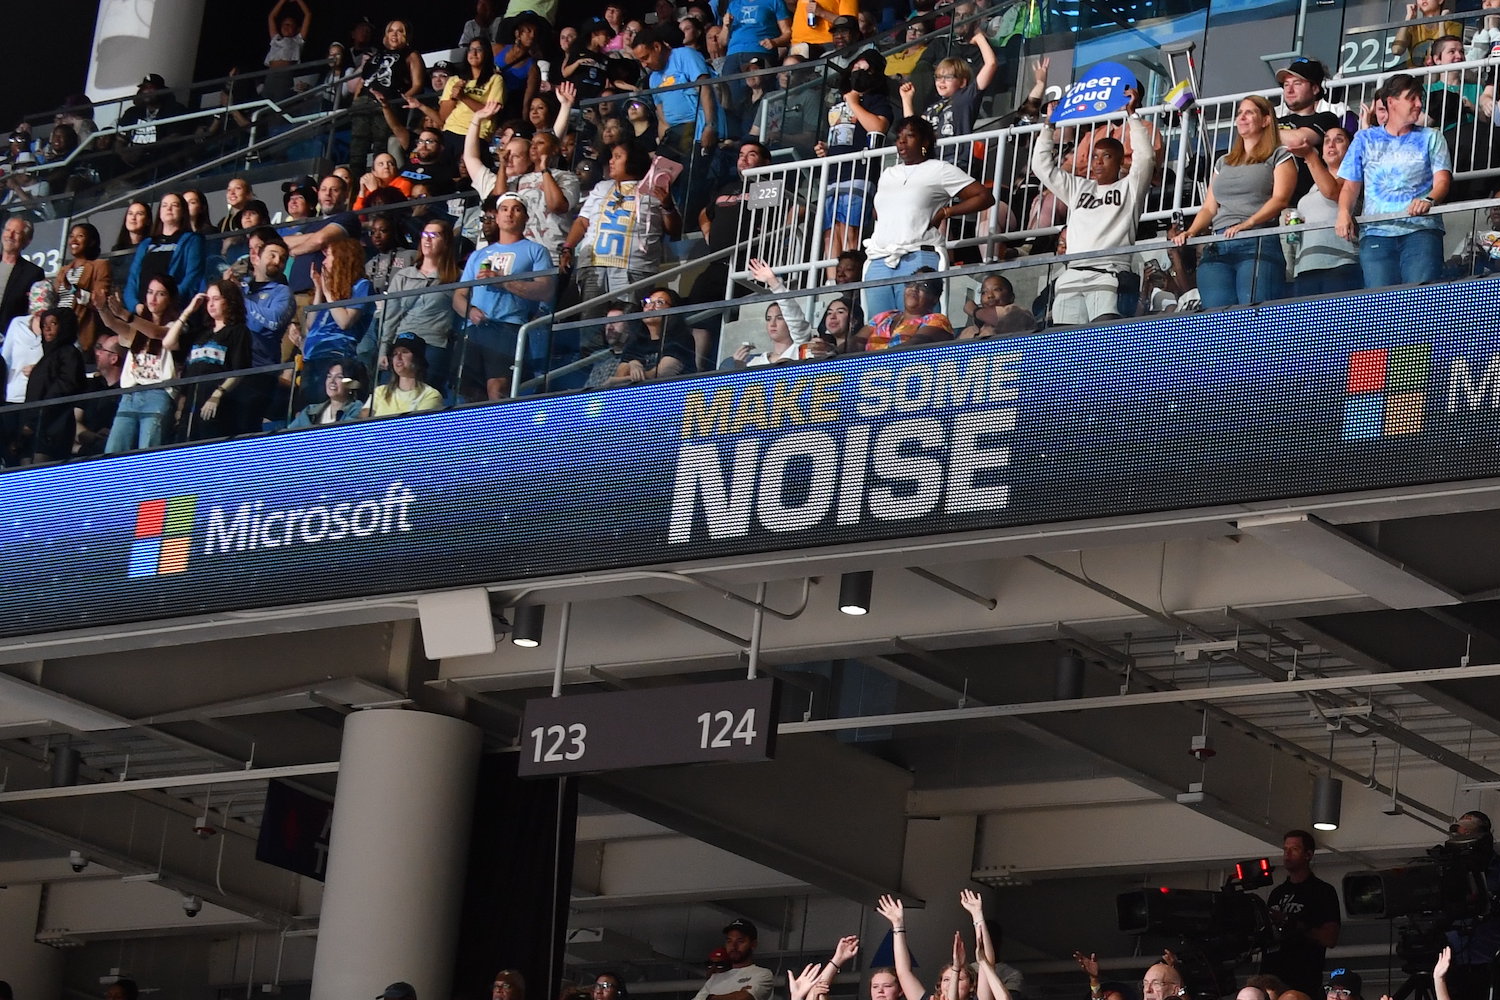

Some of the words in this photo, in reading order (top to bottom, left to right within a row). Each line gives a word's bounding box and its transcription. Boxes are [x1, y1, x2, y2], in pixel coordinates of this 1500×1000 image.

[1344, 36, 1402, 73] 225
[1064, 88, 1112, 109] Loud
[758, 188, 778, 199] 225
[681, 373, 843, 440] MAKE
[857, 354, 1024, 417] SOME
[667, 407, 1018, 544] NOISE
[204, 482, 417, 553] Microsoft
[531, 723, 587, 763] 123
[697, 708, 757, 748] 124
